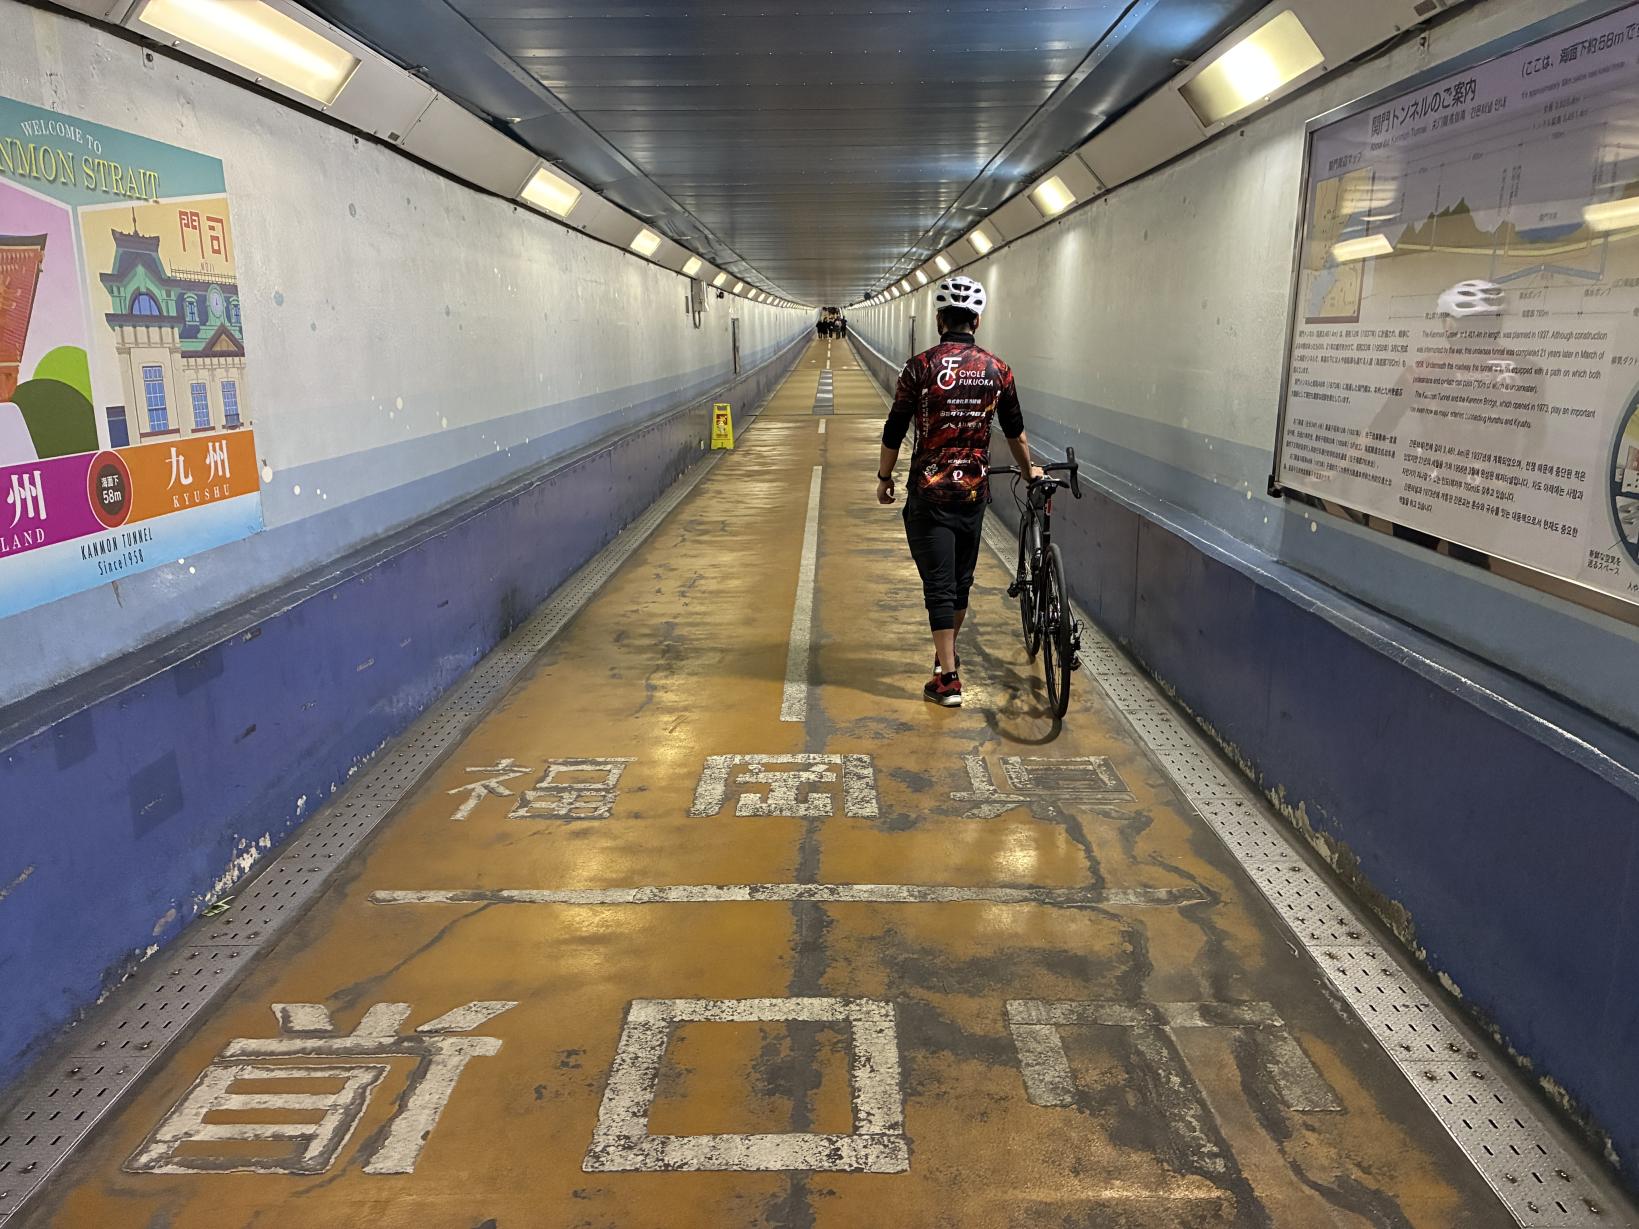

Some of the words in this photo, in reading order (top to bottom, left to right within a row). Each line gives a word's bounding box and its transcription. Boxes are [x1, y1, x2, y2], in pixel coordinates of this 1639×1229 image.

[1371, 78, 1476, 137] 関門トンネルのご案内
[21, 119, 83, 143] WELCOME
[86, 134, 102, 154] TO
[81, 155, 160, 205] STRAIT
[179, 210, 229, 263] 門司
[1550, 330, 1574, 340] Although
[1574, 330, 1607, 340] construction
[1546, 349, 1560, 359] years
[1561, 349, 1573, 359] later
[1574, 350, 1579, 359] in
[1580, 350, 1597, 360] March
[1598, 350, 1604, 360] of
[1549, 367, 1561, 377] path
[1562, 367, 1569, 377] on
[1571, 368, 1586, 378] which
[1588, 368, 1600, 379] both
[1550, 403, 1561, 414] play
[1570, 405, 1595, 418] important
[165, 440, 230, 489] 九州
[103, 489, 122, 504] 58m
[173, 484, 230, 508] KYUSHU
[80, 536, 118, 560] KANMON
[122, 527, 153, 549] TUNNEL
[448, 753, 1137, 822] 福岡県
